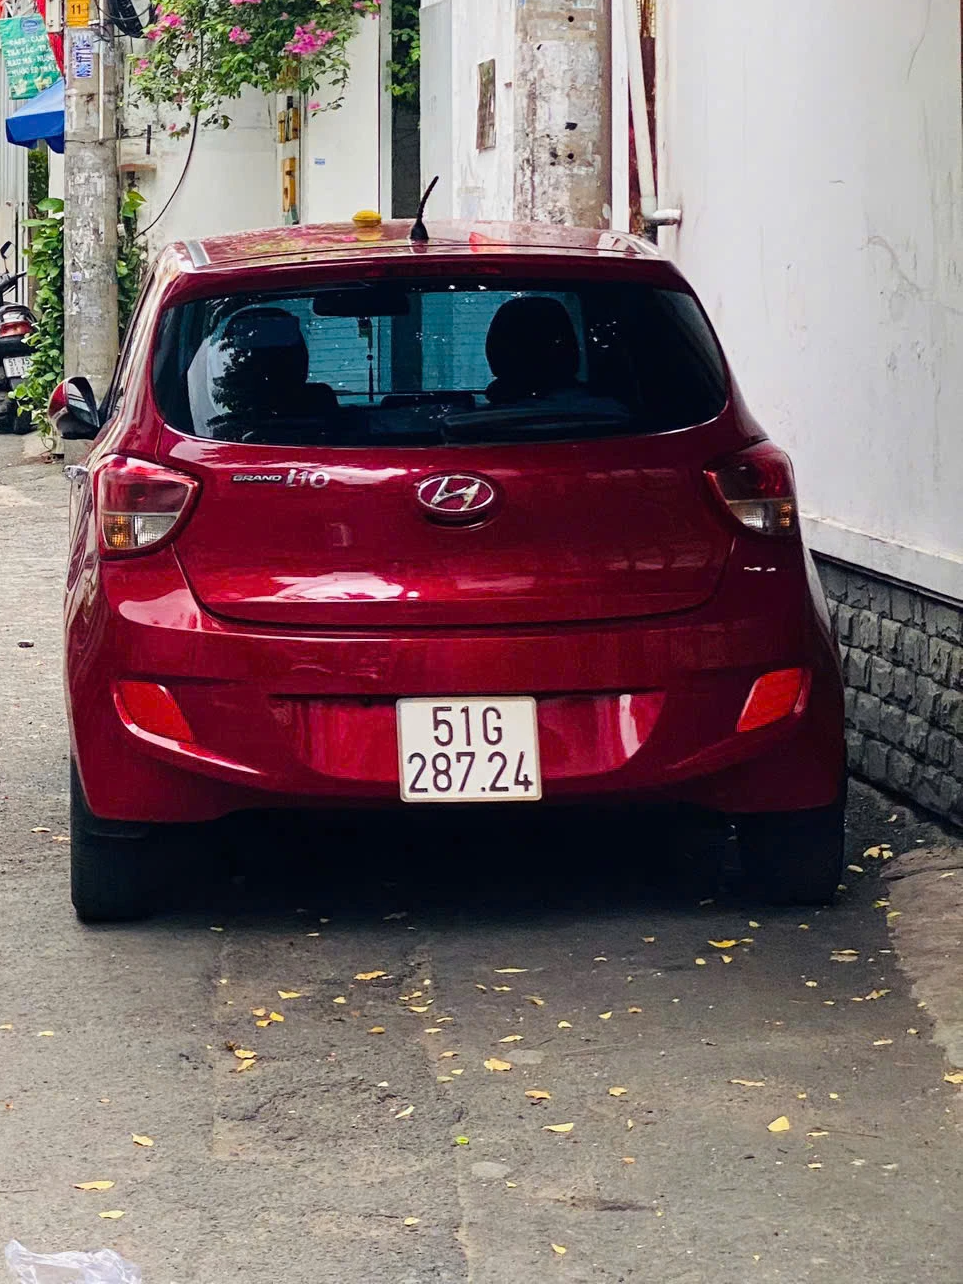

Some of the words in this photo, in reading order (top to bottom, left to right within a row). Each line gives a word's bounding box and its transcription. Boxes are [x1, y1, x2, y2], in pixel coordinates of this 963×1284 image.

[232, 474, 283, 482] GRAND
[431, 705, 503, 747] 51G
[406, 750, 535, 794] 287.24
